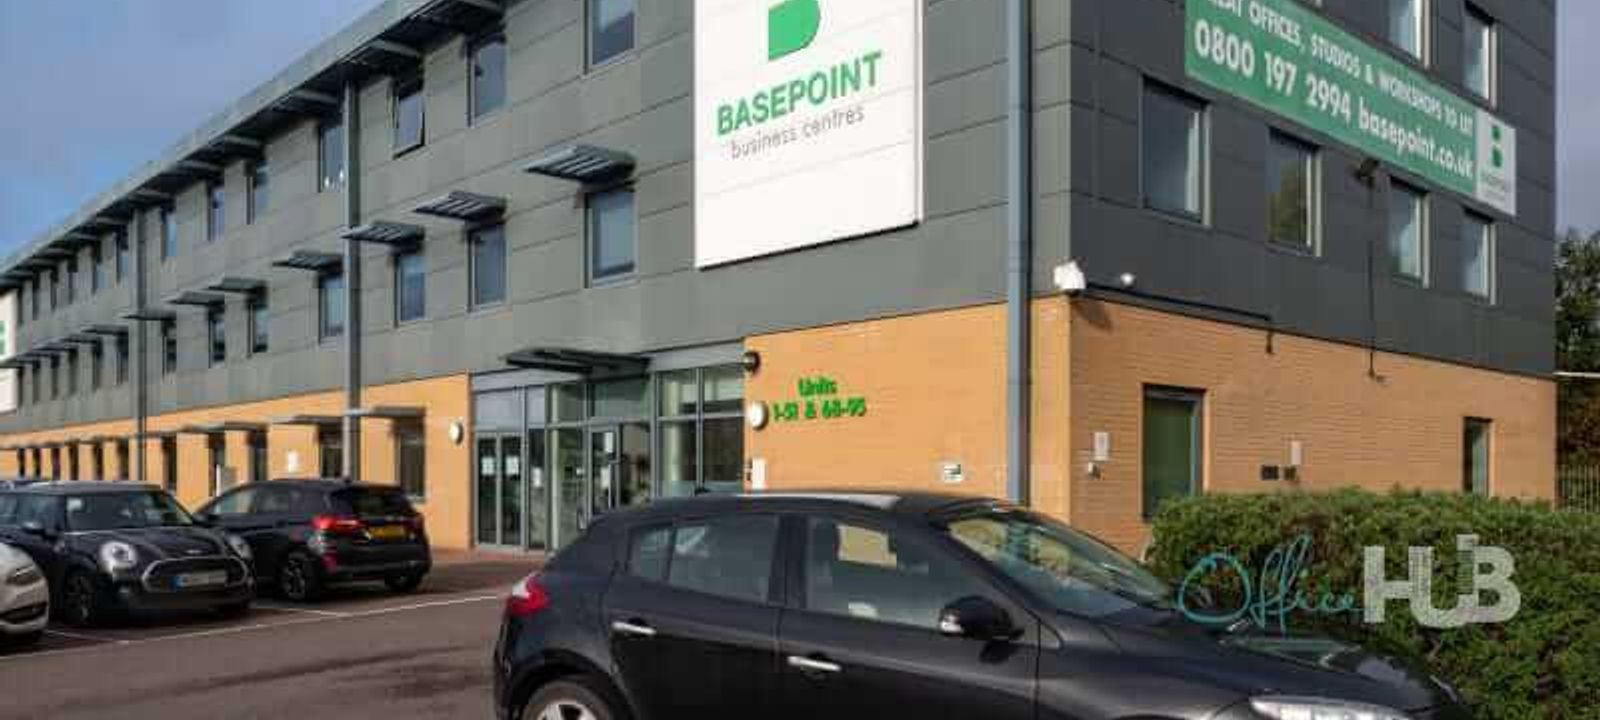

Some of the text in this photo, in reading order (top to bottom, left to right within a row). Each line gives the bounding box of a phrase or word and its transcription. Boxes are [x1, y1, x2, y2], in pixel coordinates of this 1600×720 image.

[716, 50, 882, 136] BASEPOINT
[1195, 18, 1473, 180] 0800 197 2994 basepoint.co.uk
[1311, 33, 1360, 78] STUDIOS
[1365, 64, 1374, 85] &
[1377, 71, 1441, 121] WORKSHOPS
[1444, 105, 1457, 128] TO
[730, 105, 865, 160] business centres
[798, 376, 838, 397] Units
[804, 400, 816, 419] &
